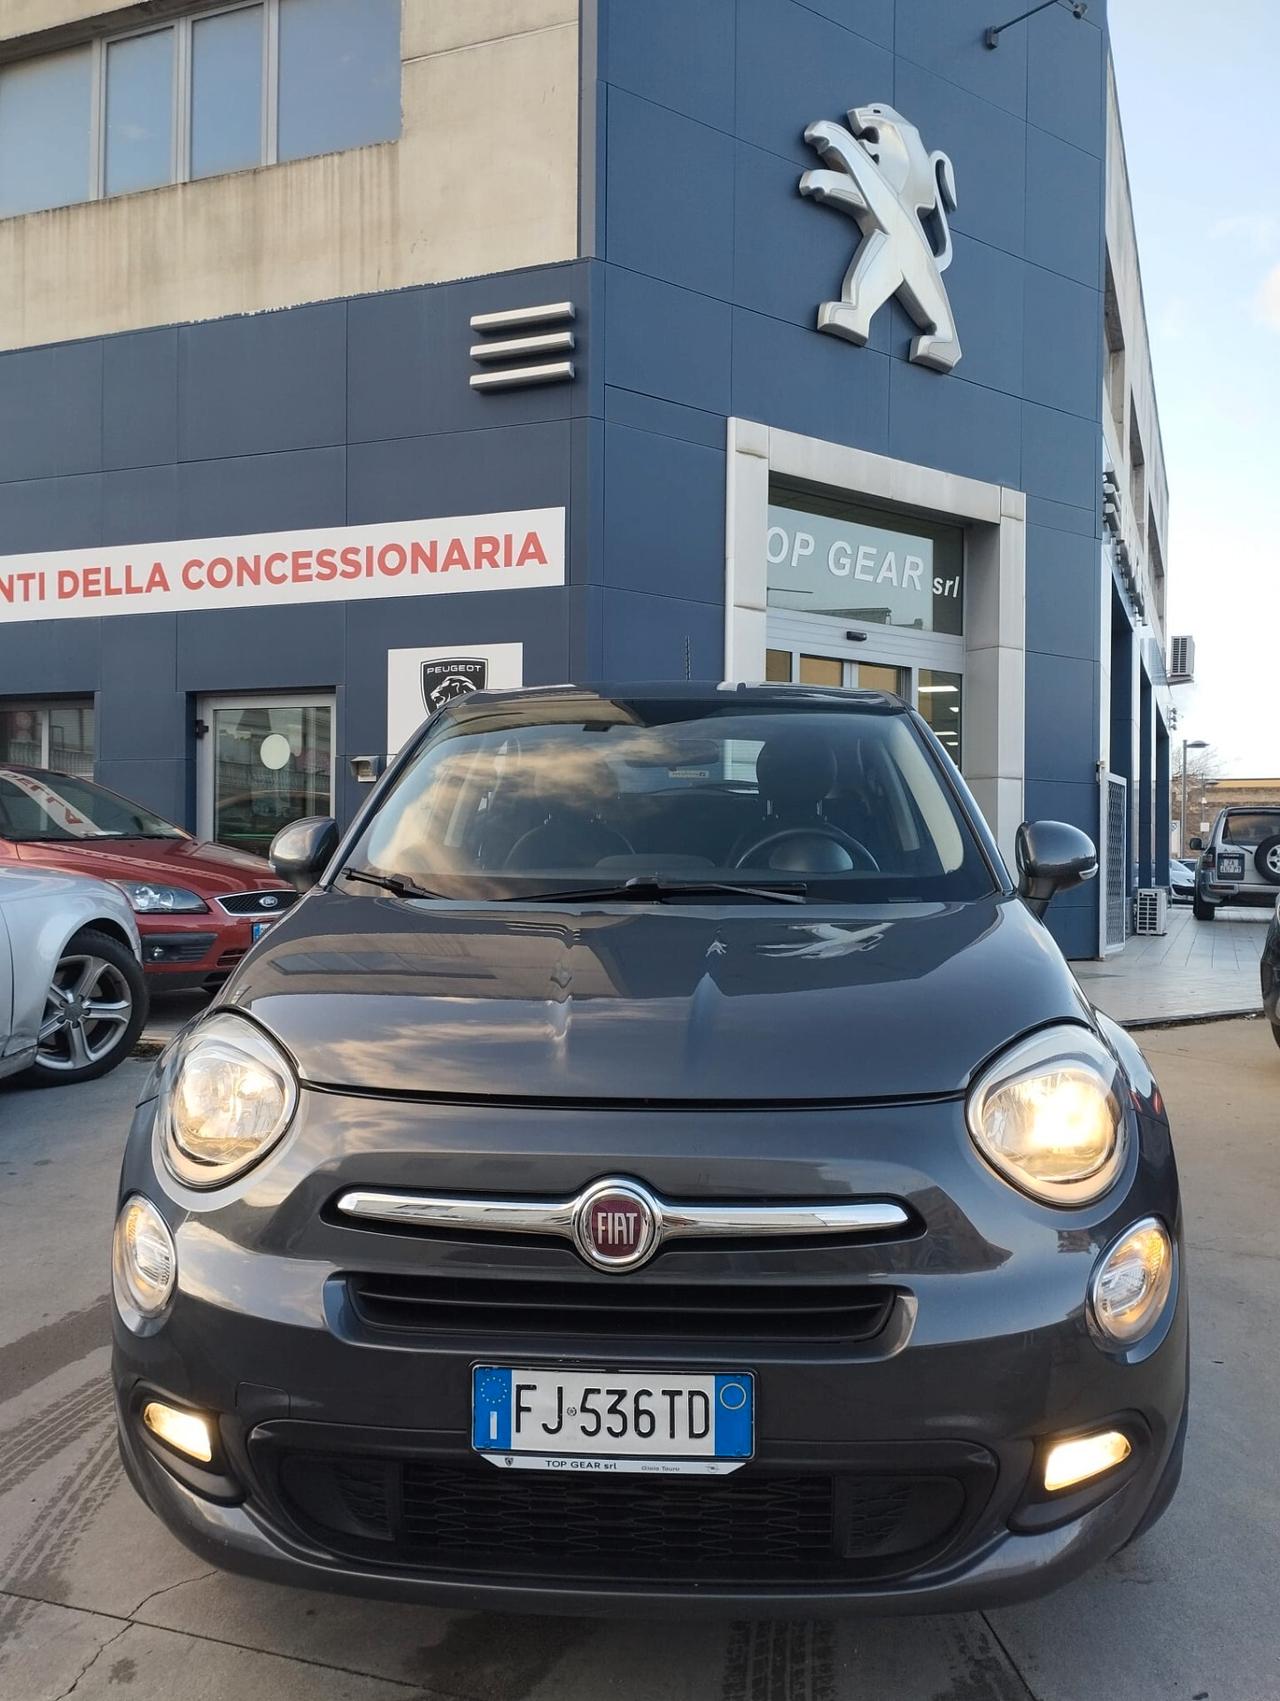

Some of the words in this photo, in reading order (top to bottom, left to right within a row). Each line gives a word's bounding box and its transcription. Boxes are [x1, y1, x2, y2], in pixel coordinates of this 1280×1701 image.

[58, 562, 171, 599] DELLA
[182, 531, 548, 591] CONCESSIONARIA
[828, 541, 924, 591] GEAR
[932, 576, 960, 598] srl
[426, 664, 483, 674] PEUGEOT
[597, 1212, 638, 1245] FIAT
[545, 1460, 567, 1468] TOP
[570, 1461, 600, 1469] GEAR
[604, 1462, 617, 1470] srl
